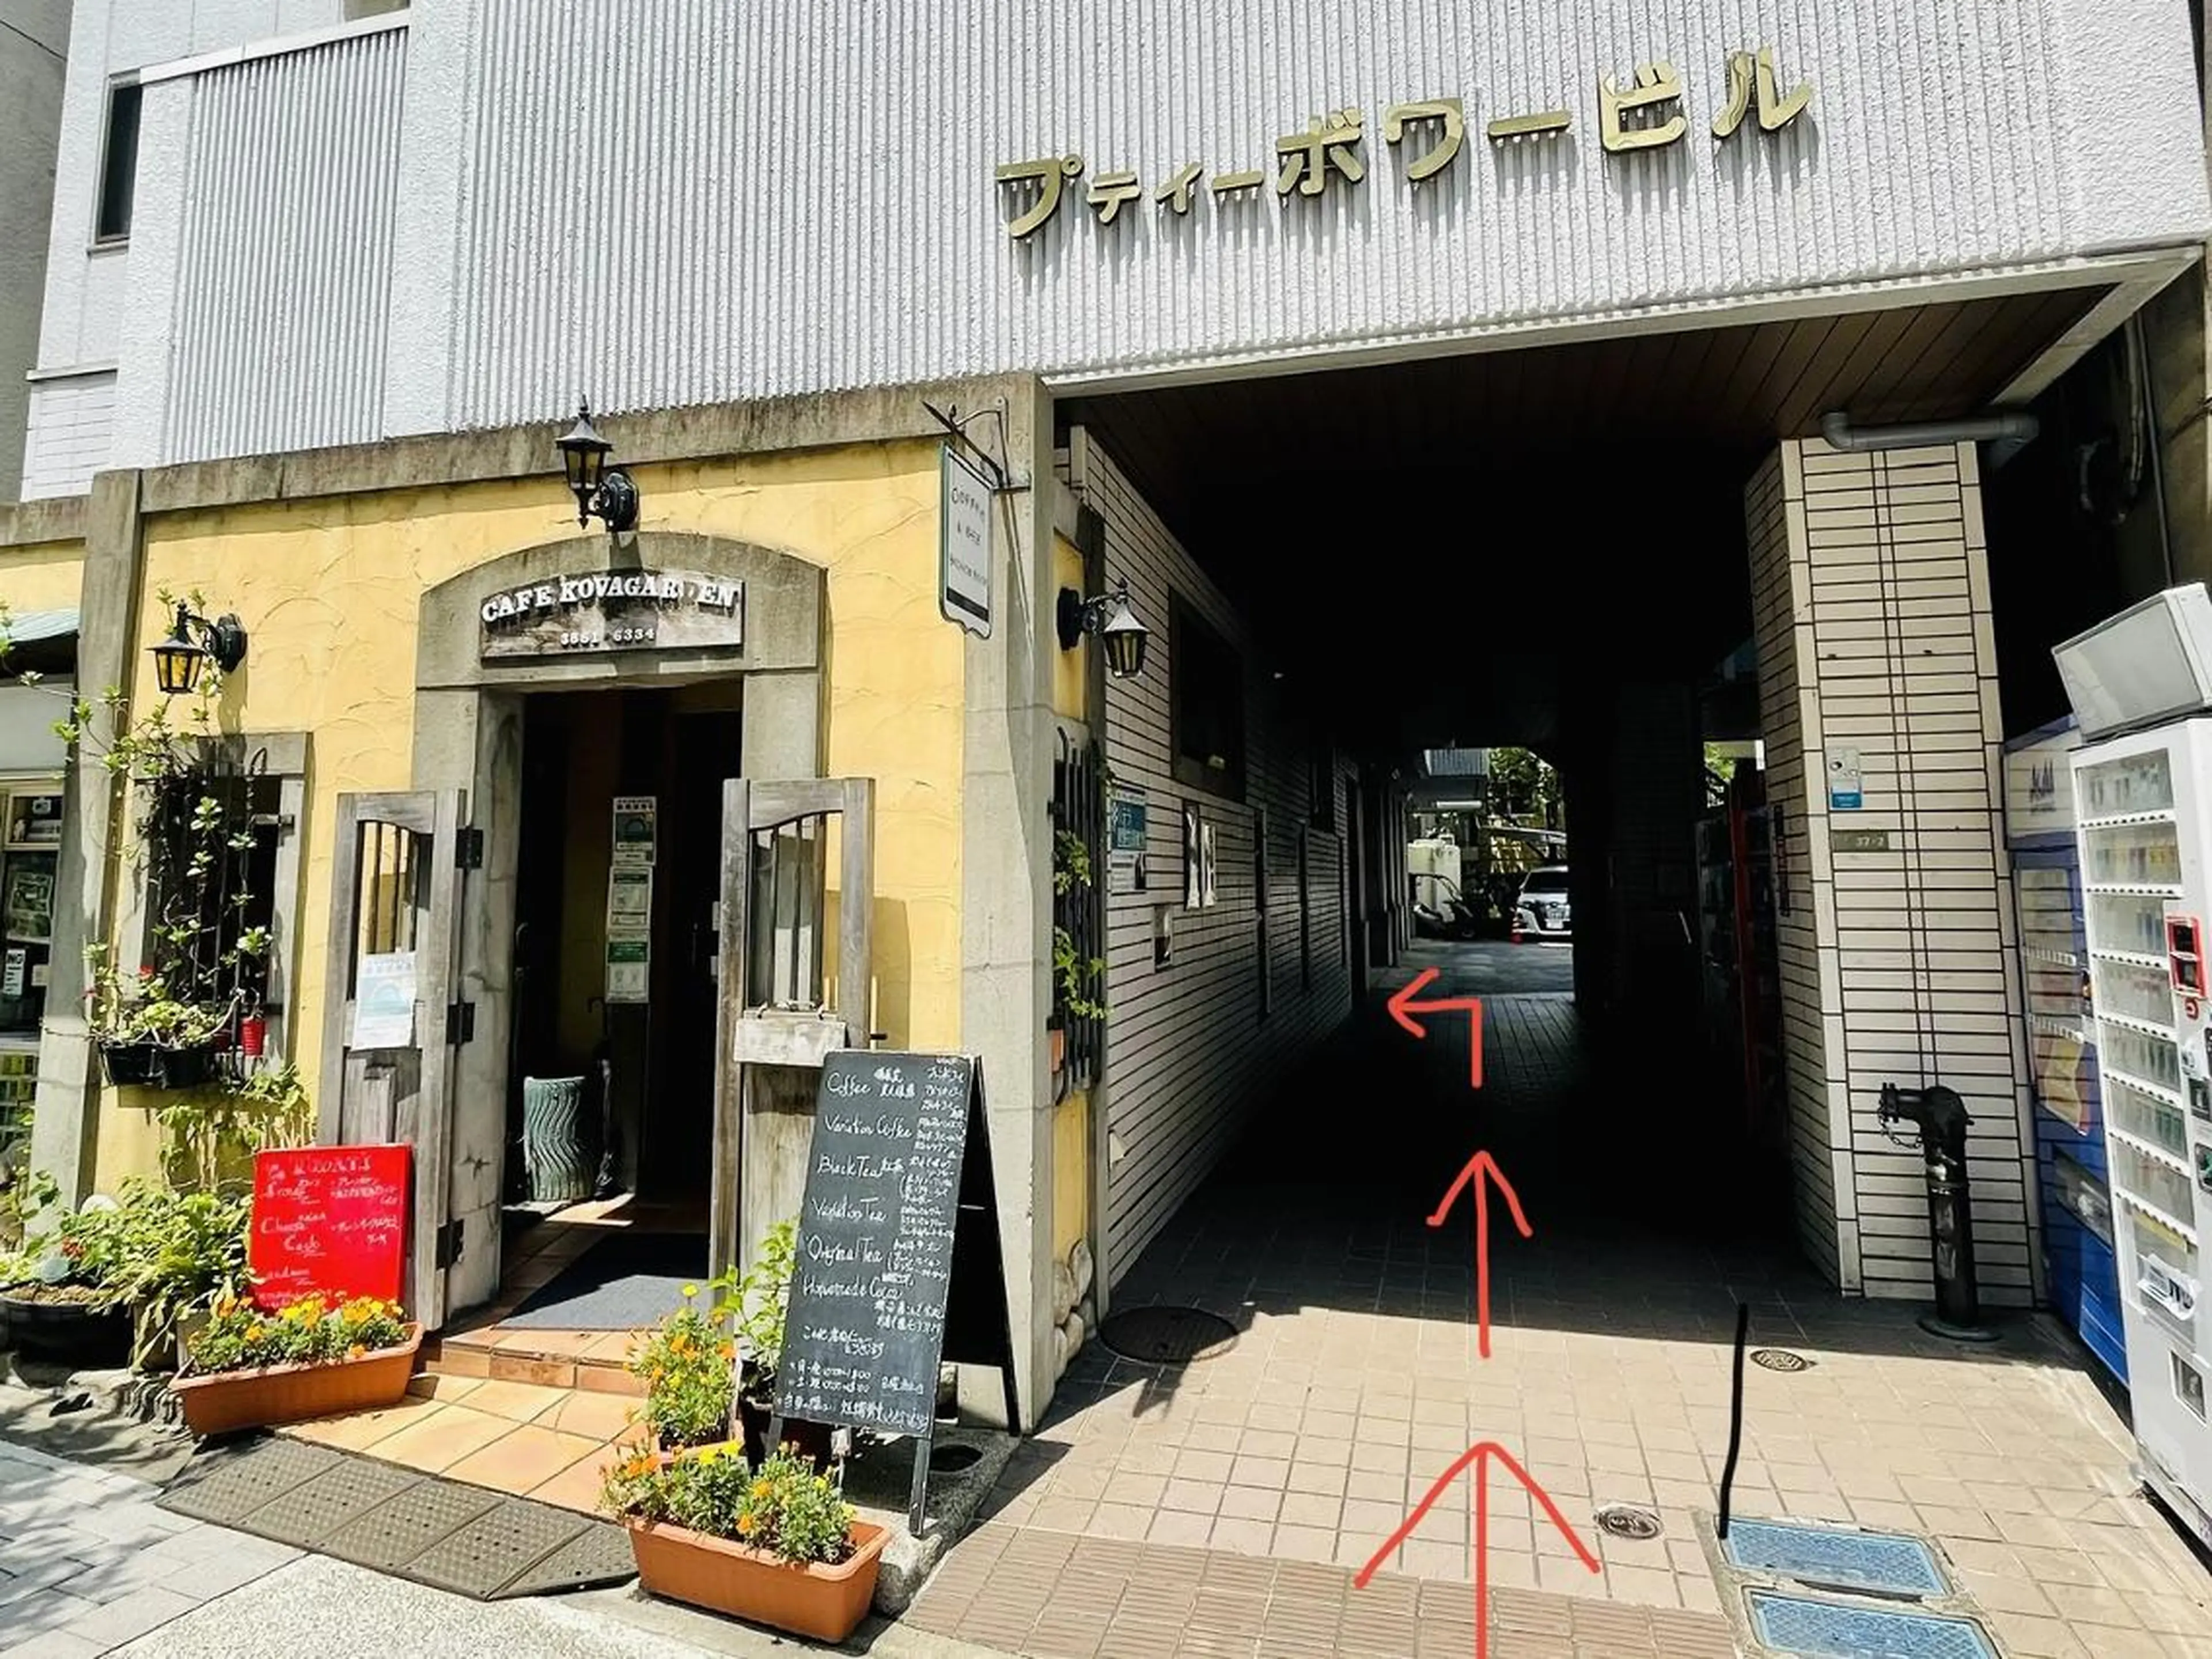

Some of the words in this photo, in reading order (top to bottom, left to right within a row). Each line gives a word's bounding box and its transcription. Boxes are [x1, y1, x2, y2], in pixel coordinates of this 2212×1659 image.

[995, 47, 1815, 237] プティーボワービル
[482, 585, 554, 622] CAFE
[612, 627, 655, 642] 6334
[827, 1072, 871, 1097] Coffee
